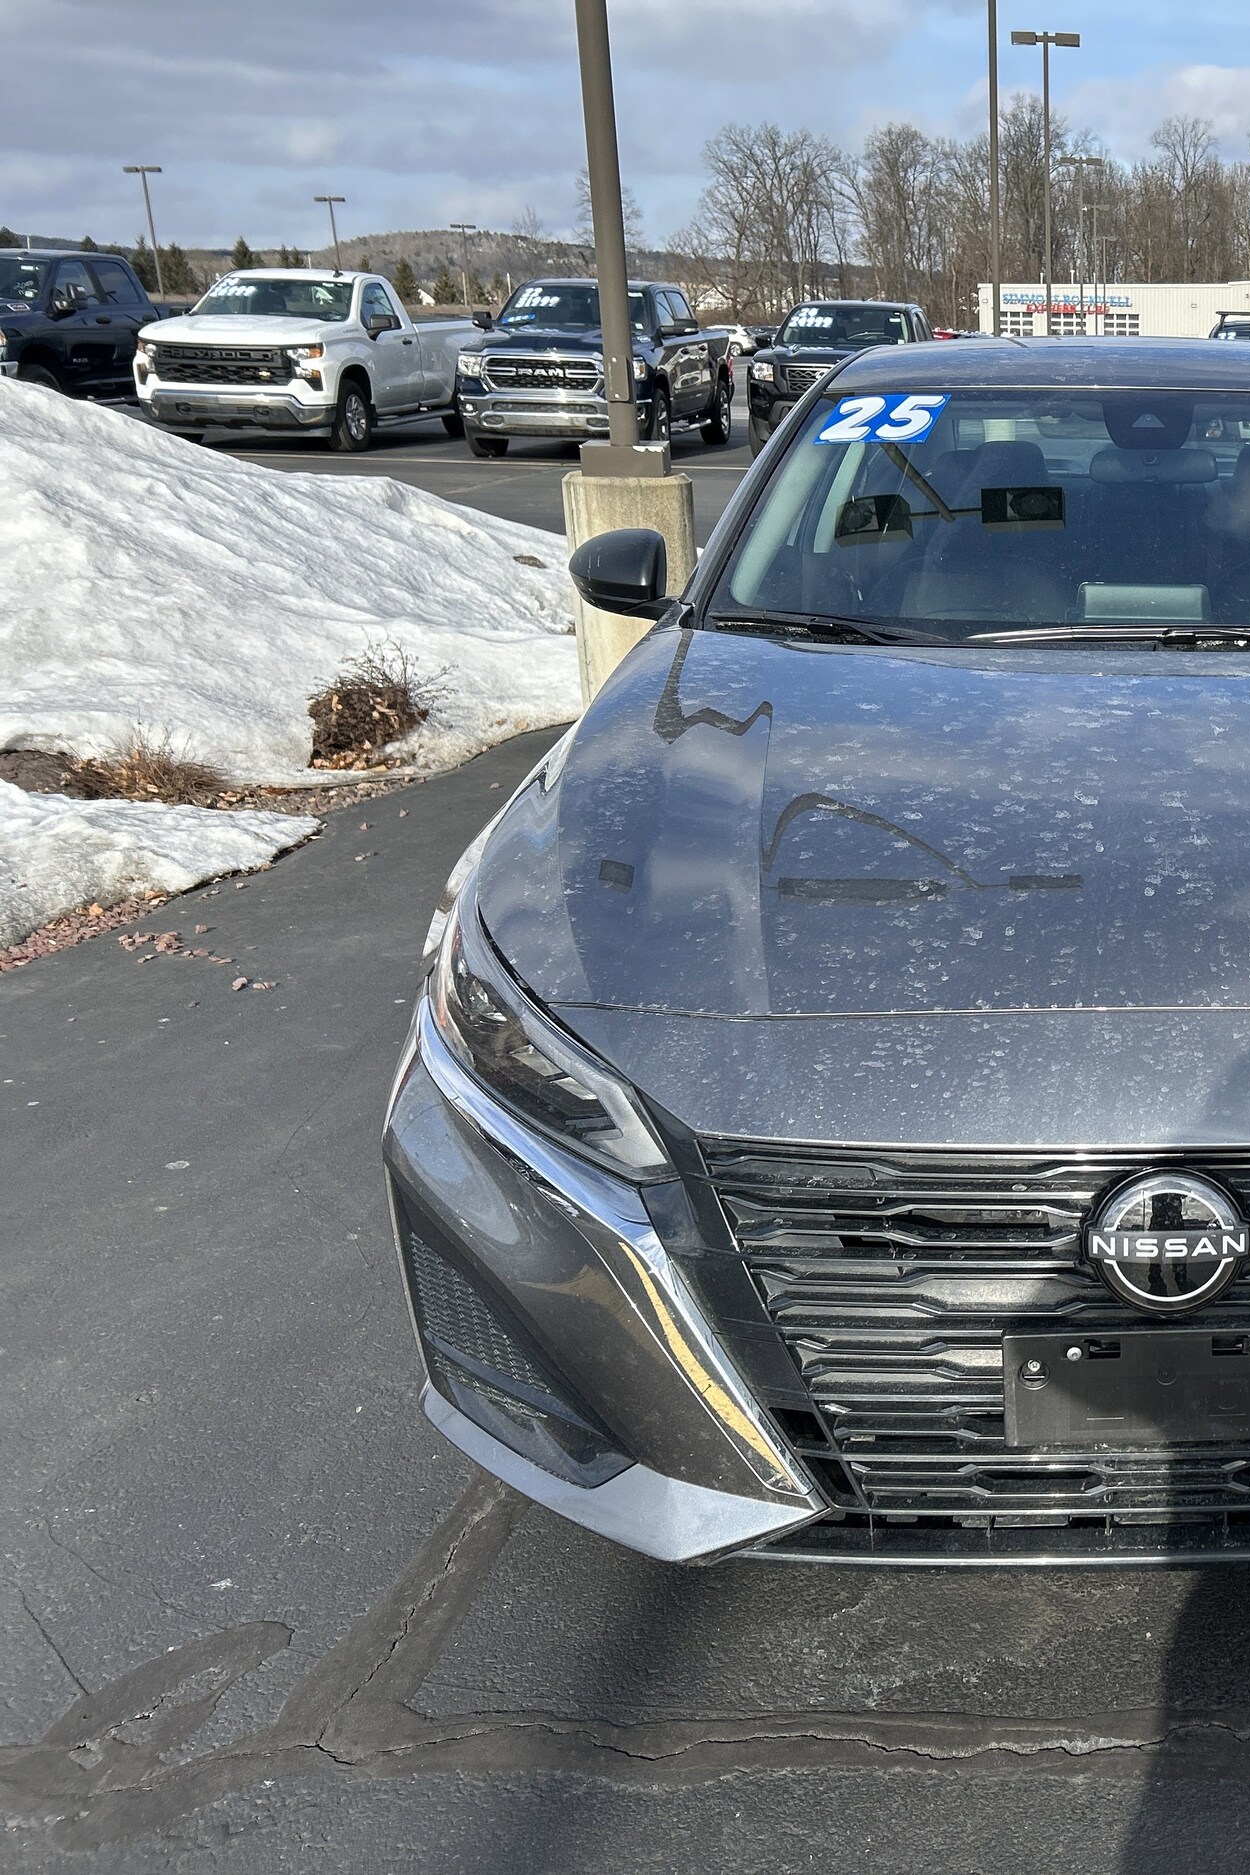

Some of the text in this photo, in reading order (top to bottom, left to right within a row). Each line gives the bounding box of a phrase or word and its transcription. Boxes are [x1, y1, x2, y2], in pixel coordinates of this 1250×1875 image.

[1003, 293, 1060, 305] SIMMOS
[518, 367, 564, 378] RAM
[819, 395, 946, 442] 25
[1092, 1233, 1245, 1258] NISSAN
